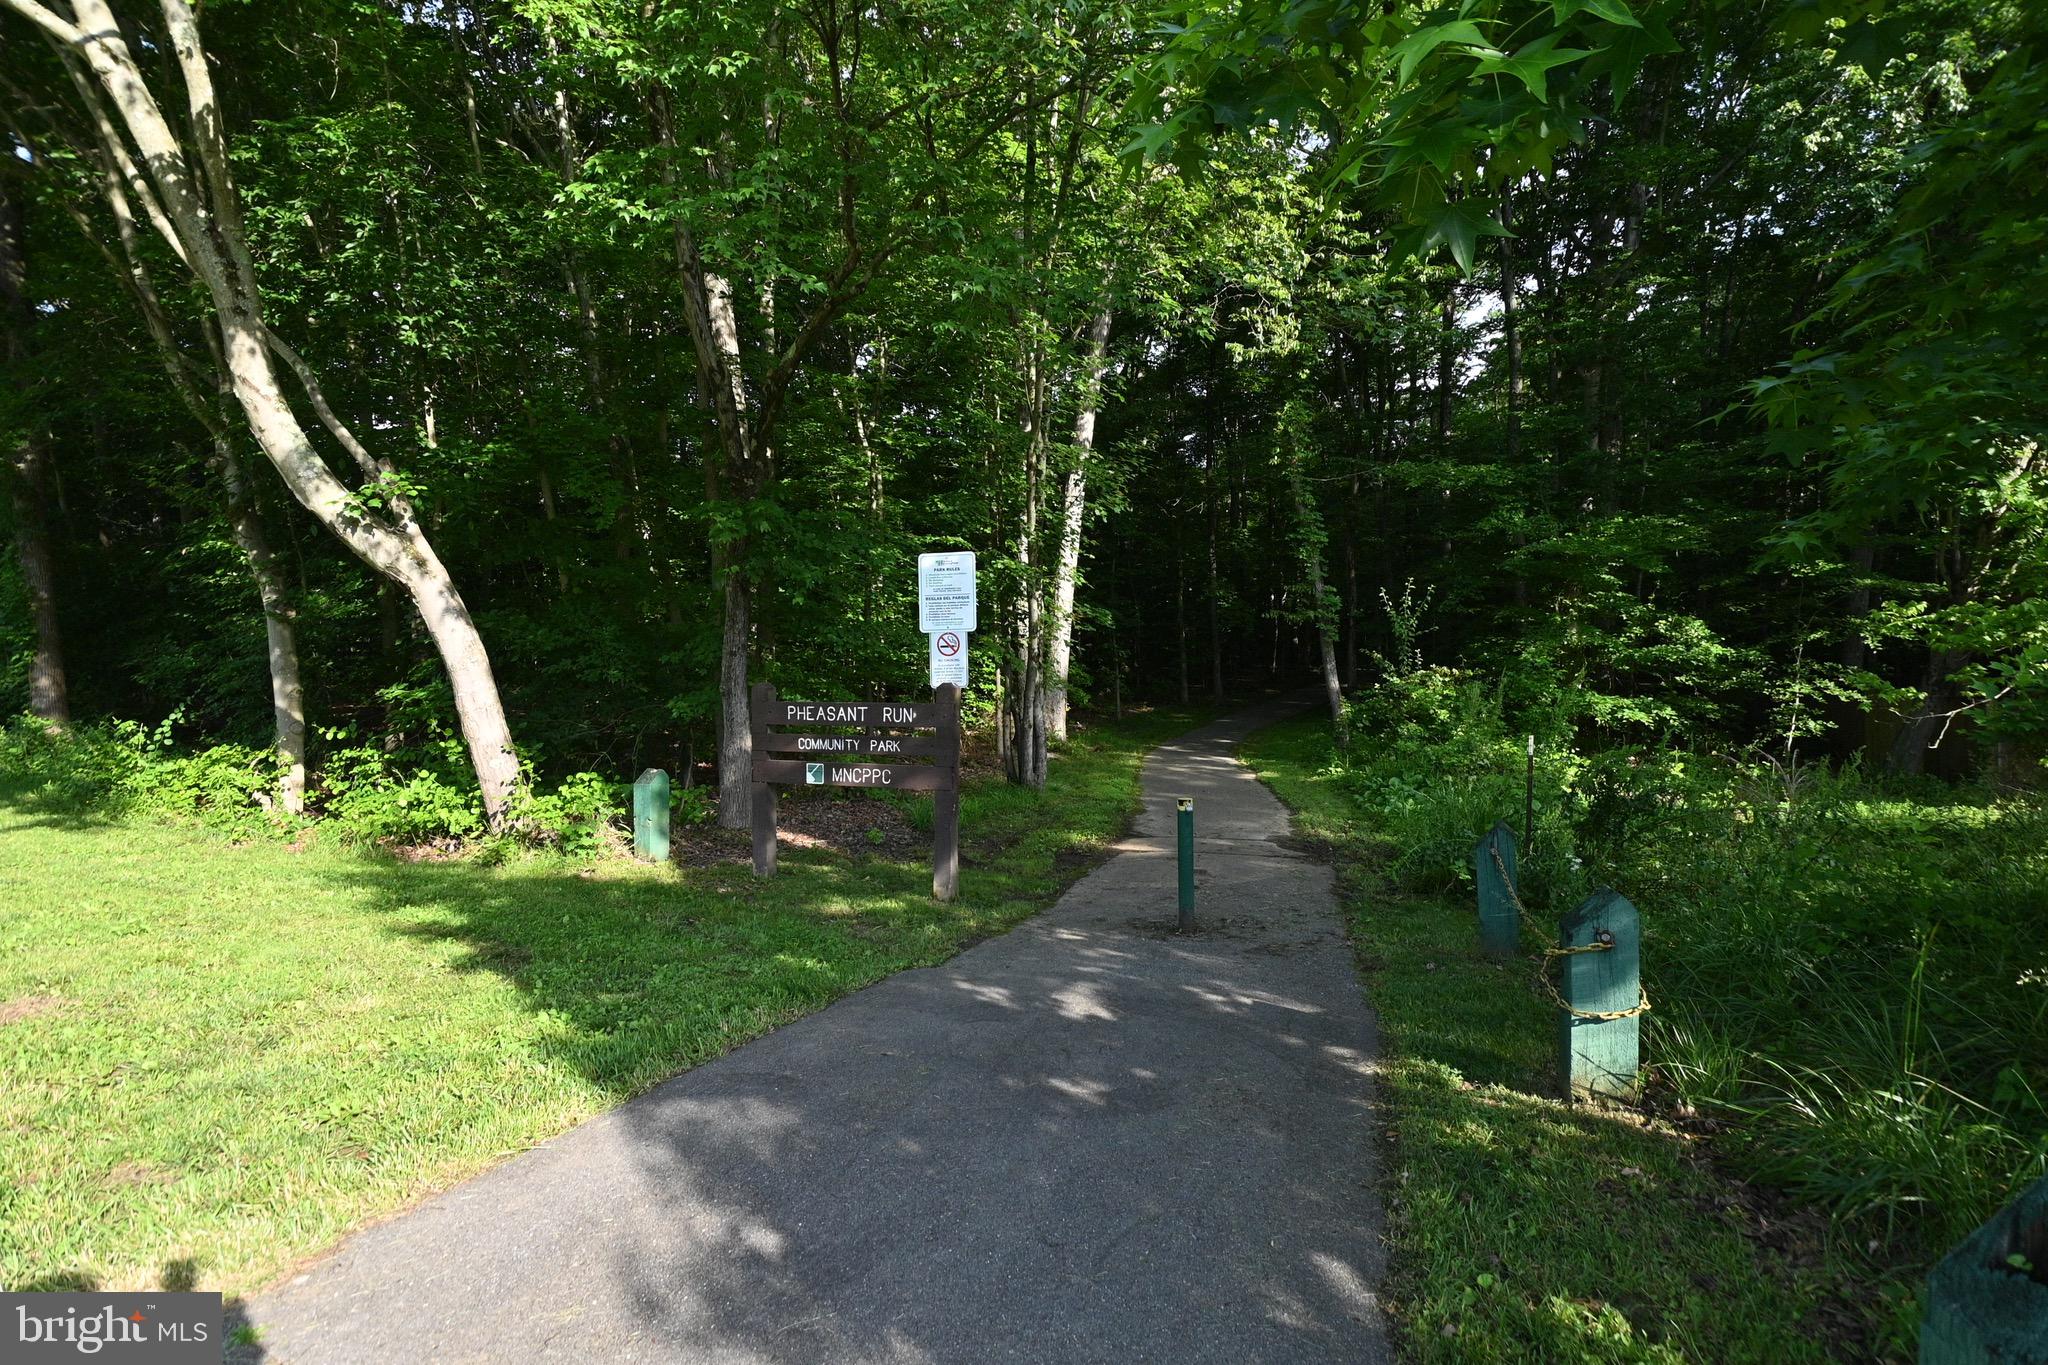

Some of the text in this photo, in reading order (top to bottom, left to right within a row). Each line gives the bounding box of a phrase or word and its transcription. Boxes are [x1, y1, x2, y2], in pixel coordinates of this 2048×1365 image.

[787, 705, 913, 723] PHEASANT RUN
[798, 737, 901, 752] COMMUNITY PARK
[832, 767, 892, 785] MNCPPC
